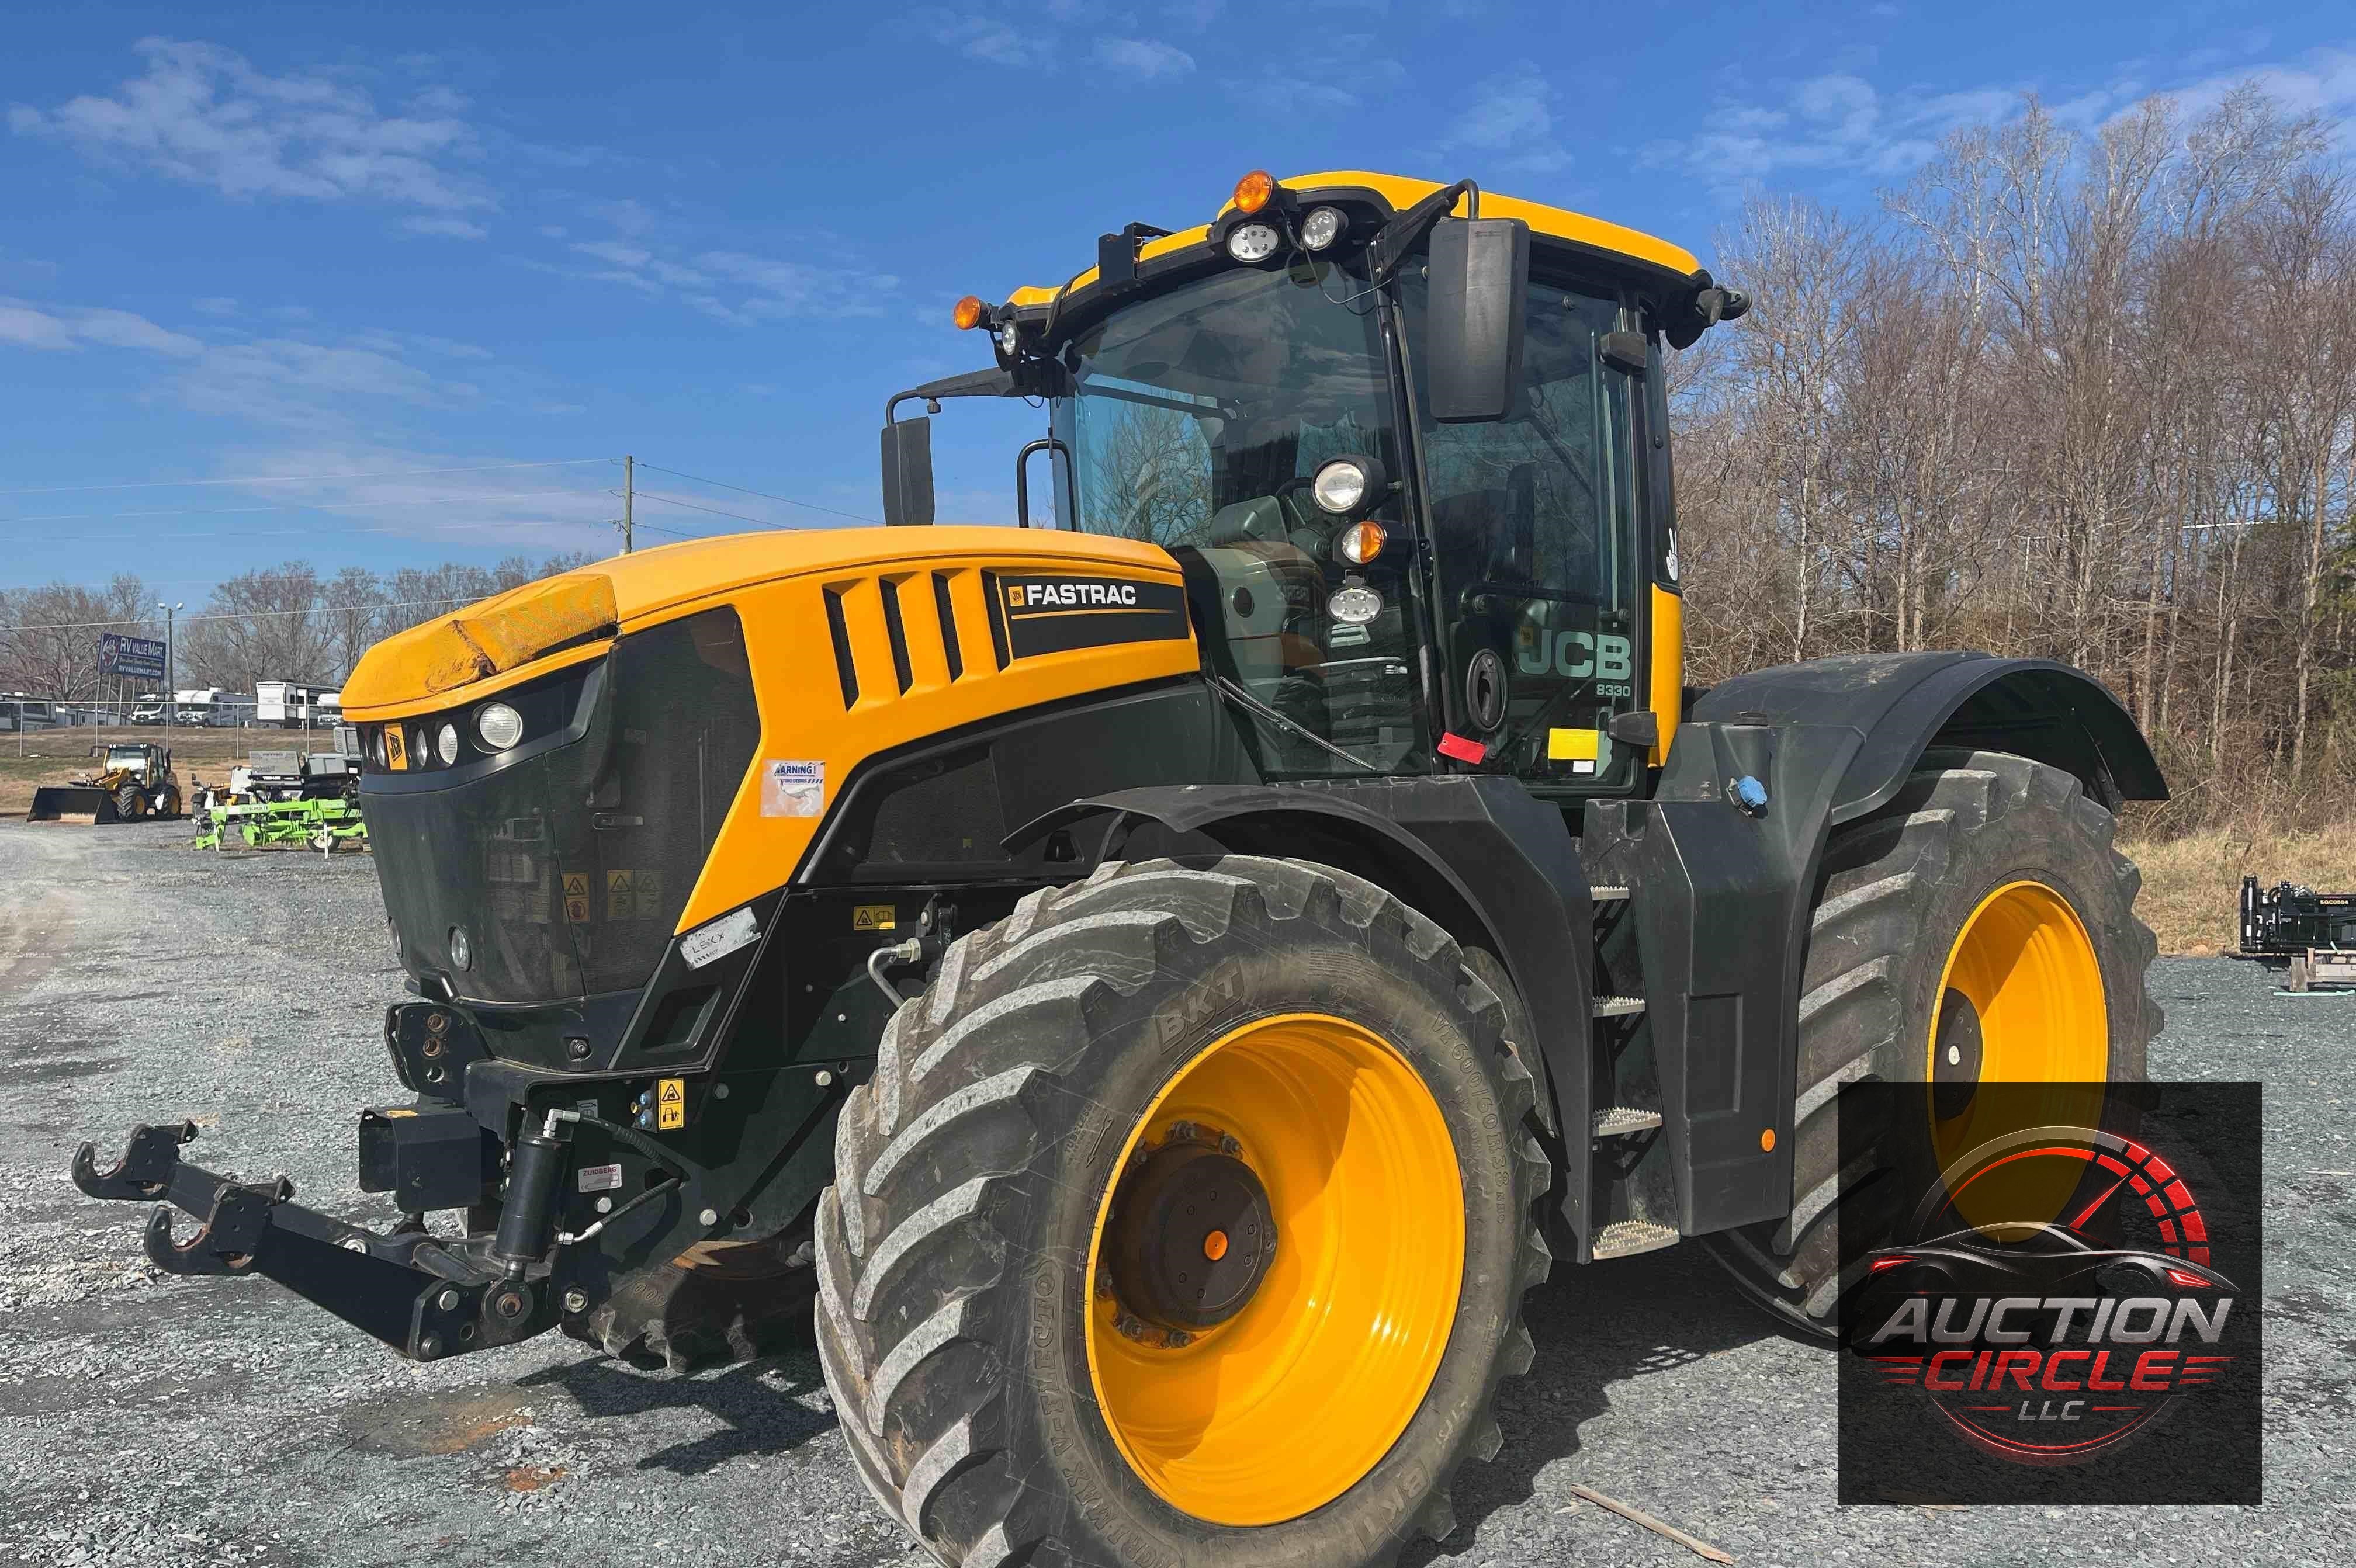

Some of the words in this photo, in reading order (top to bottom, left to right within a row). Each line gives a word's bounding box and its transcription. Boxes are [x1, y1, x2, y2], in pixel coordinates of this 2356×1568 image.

[1027, 585, 1136, 605] FASTRAC
[120, 637, 133, 653] RV
[1519, 629, 1631, 680] JCB
[1596, 684, 1630, 696] 8330
[1156, 958, 1244, 1054] BKT
